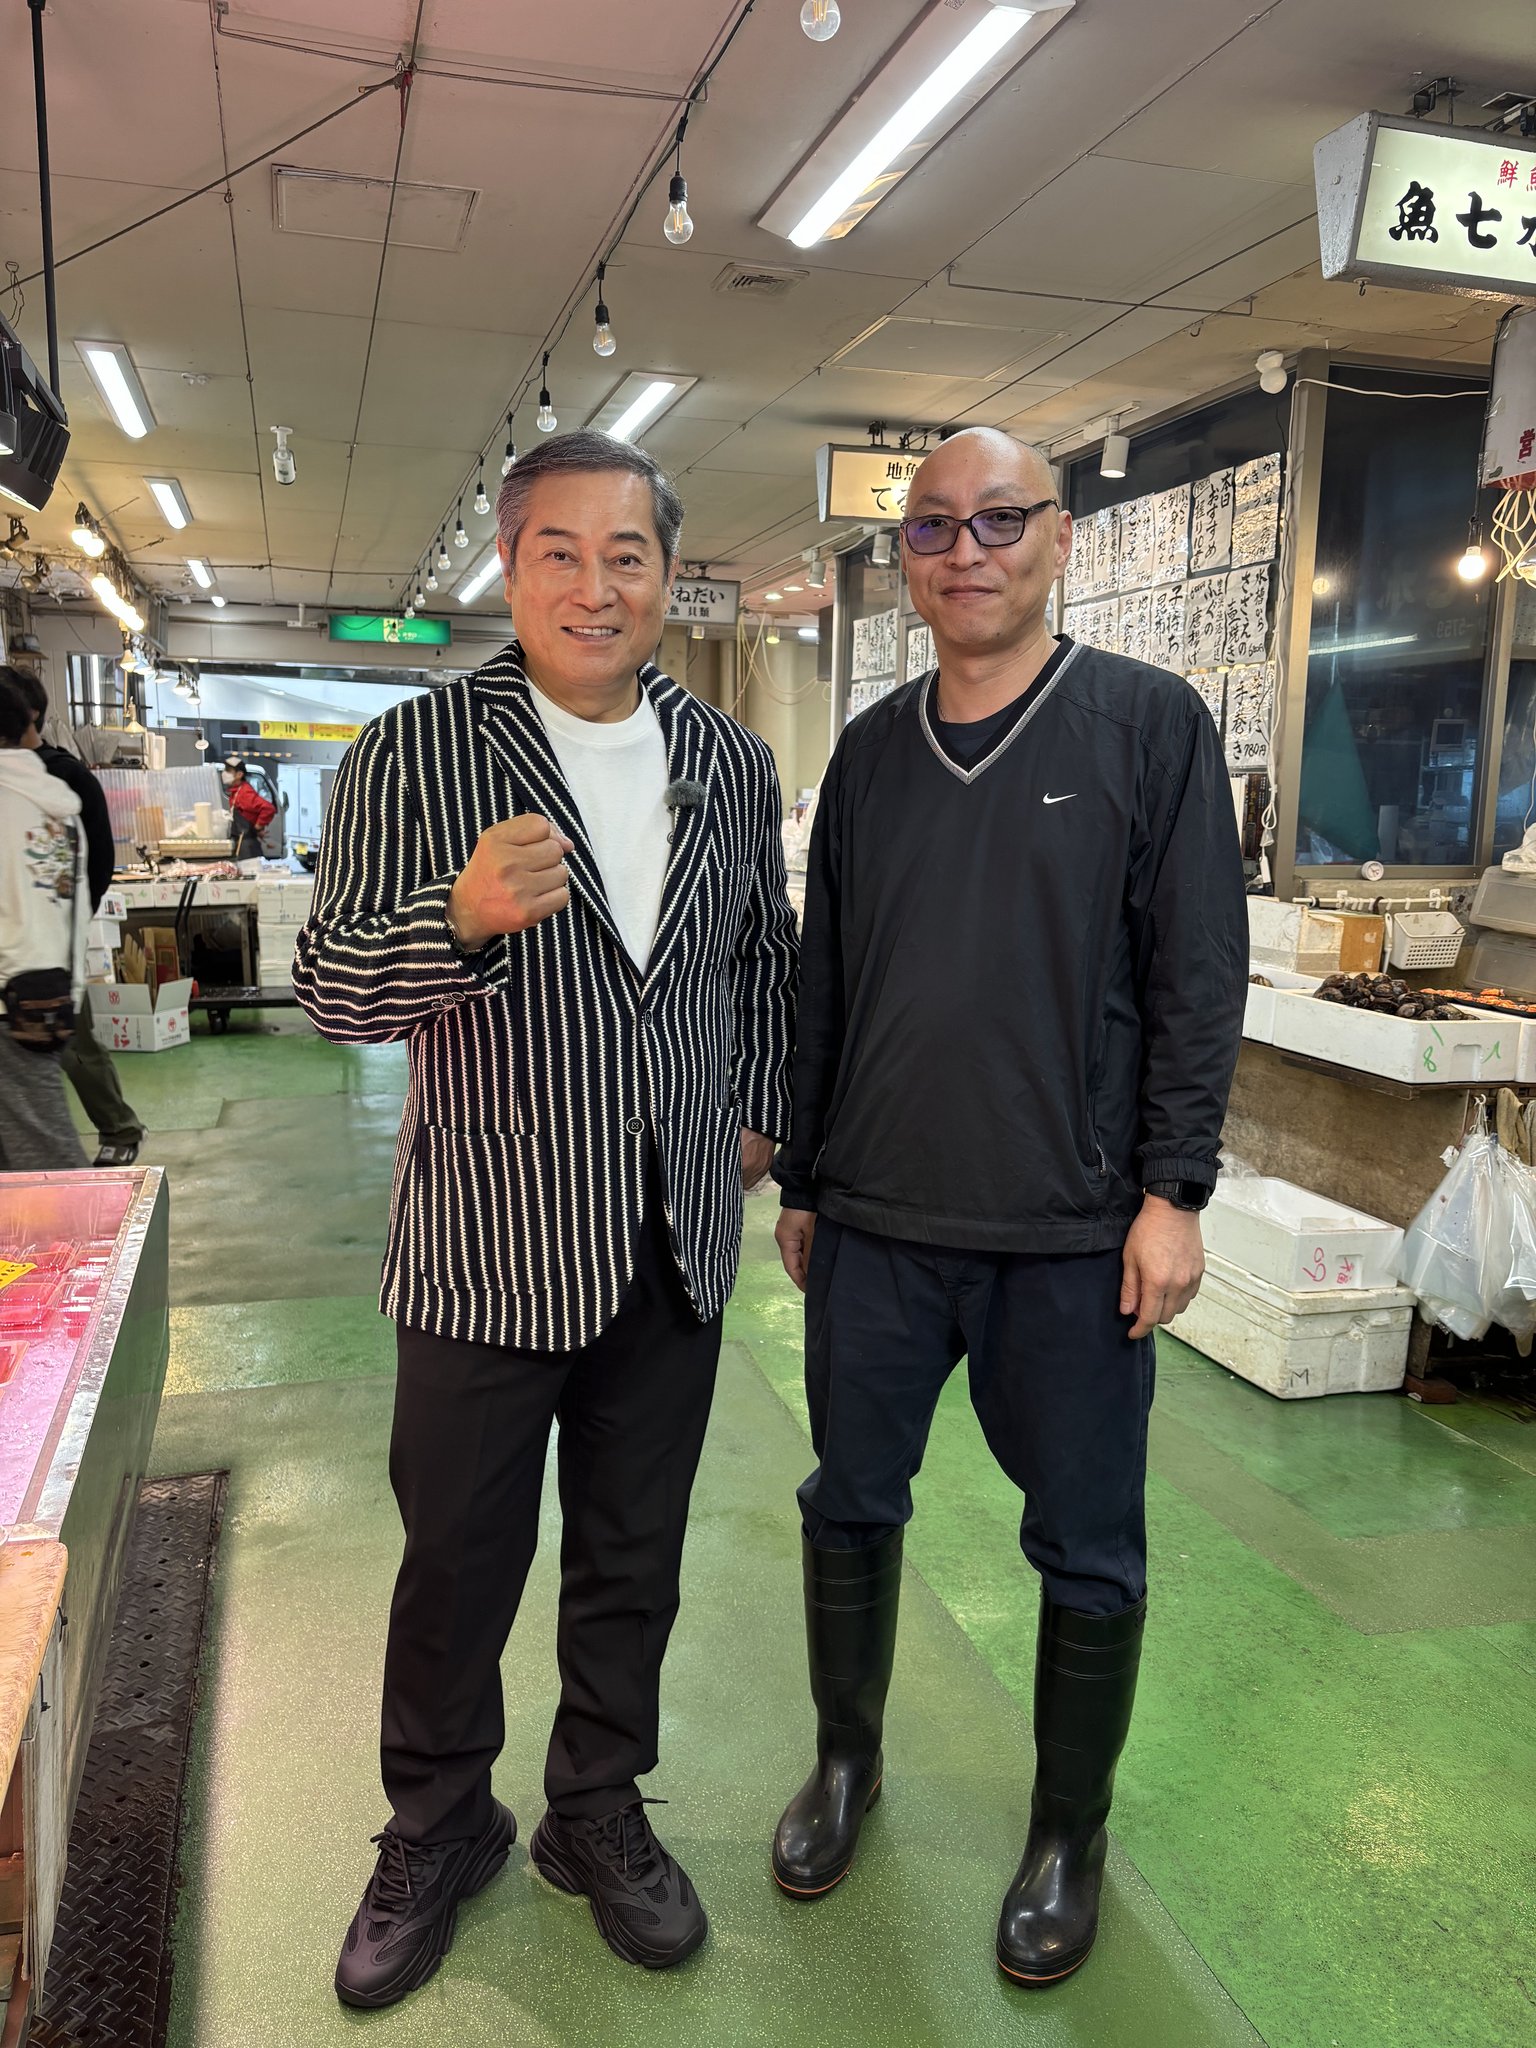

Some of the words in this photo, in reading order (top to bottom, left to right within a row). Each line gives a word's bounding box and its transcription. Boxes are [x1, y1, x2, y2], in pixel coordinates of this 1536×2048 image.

[1204, 484, 1219, 559] おすすめ
[671, 587, 725, 604] ねだい
[285, 723, 298, 734] IN
[1290, 1368, 1309, 1388] M
